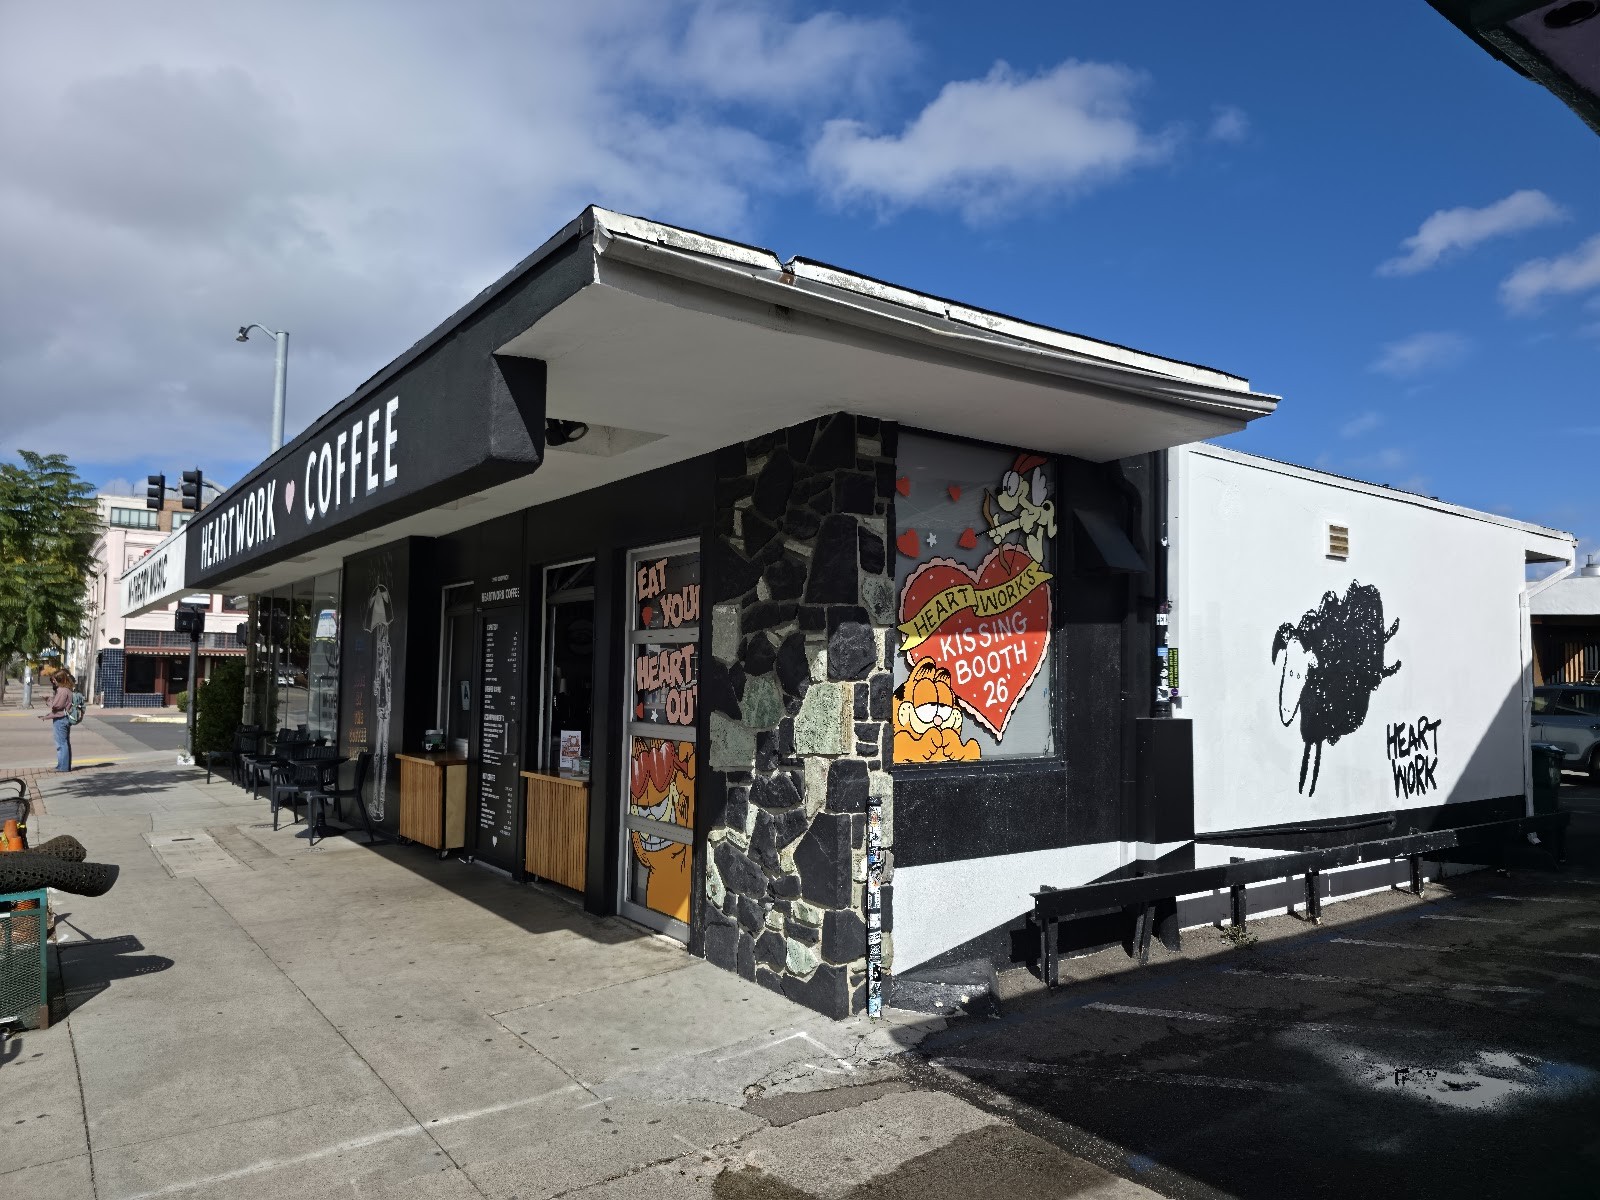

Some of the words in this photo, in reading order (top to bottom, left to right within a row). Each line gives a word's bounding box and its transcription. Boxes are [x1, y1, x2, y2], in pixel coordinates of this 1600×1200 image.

[305, 396, 399, 523] COFFEE
[150, 554, 168, 595] MUSIC
[637, 558, 668, 601] EAT
[914, 588, 968, 638] HEART
[979, 569, 1036, 612] WORK'S
[940, 611, 1028, 661] KISSING
[637, 643, 695, 691] HEART
[956, 640, 1028, 685] BOOTH
[665, 684, 698, 725] OU
[1386, 716, 1441, 760] HEART
[1392, 754, 1438, 799] WORK
